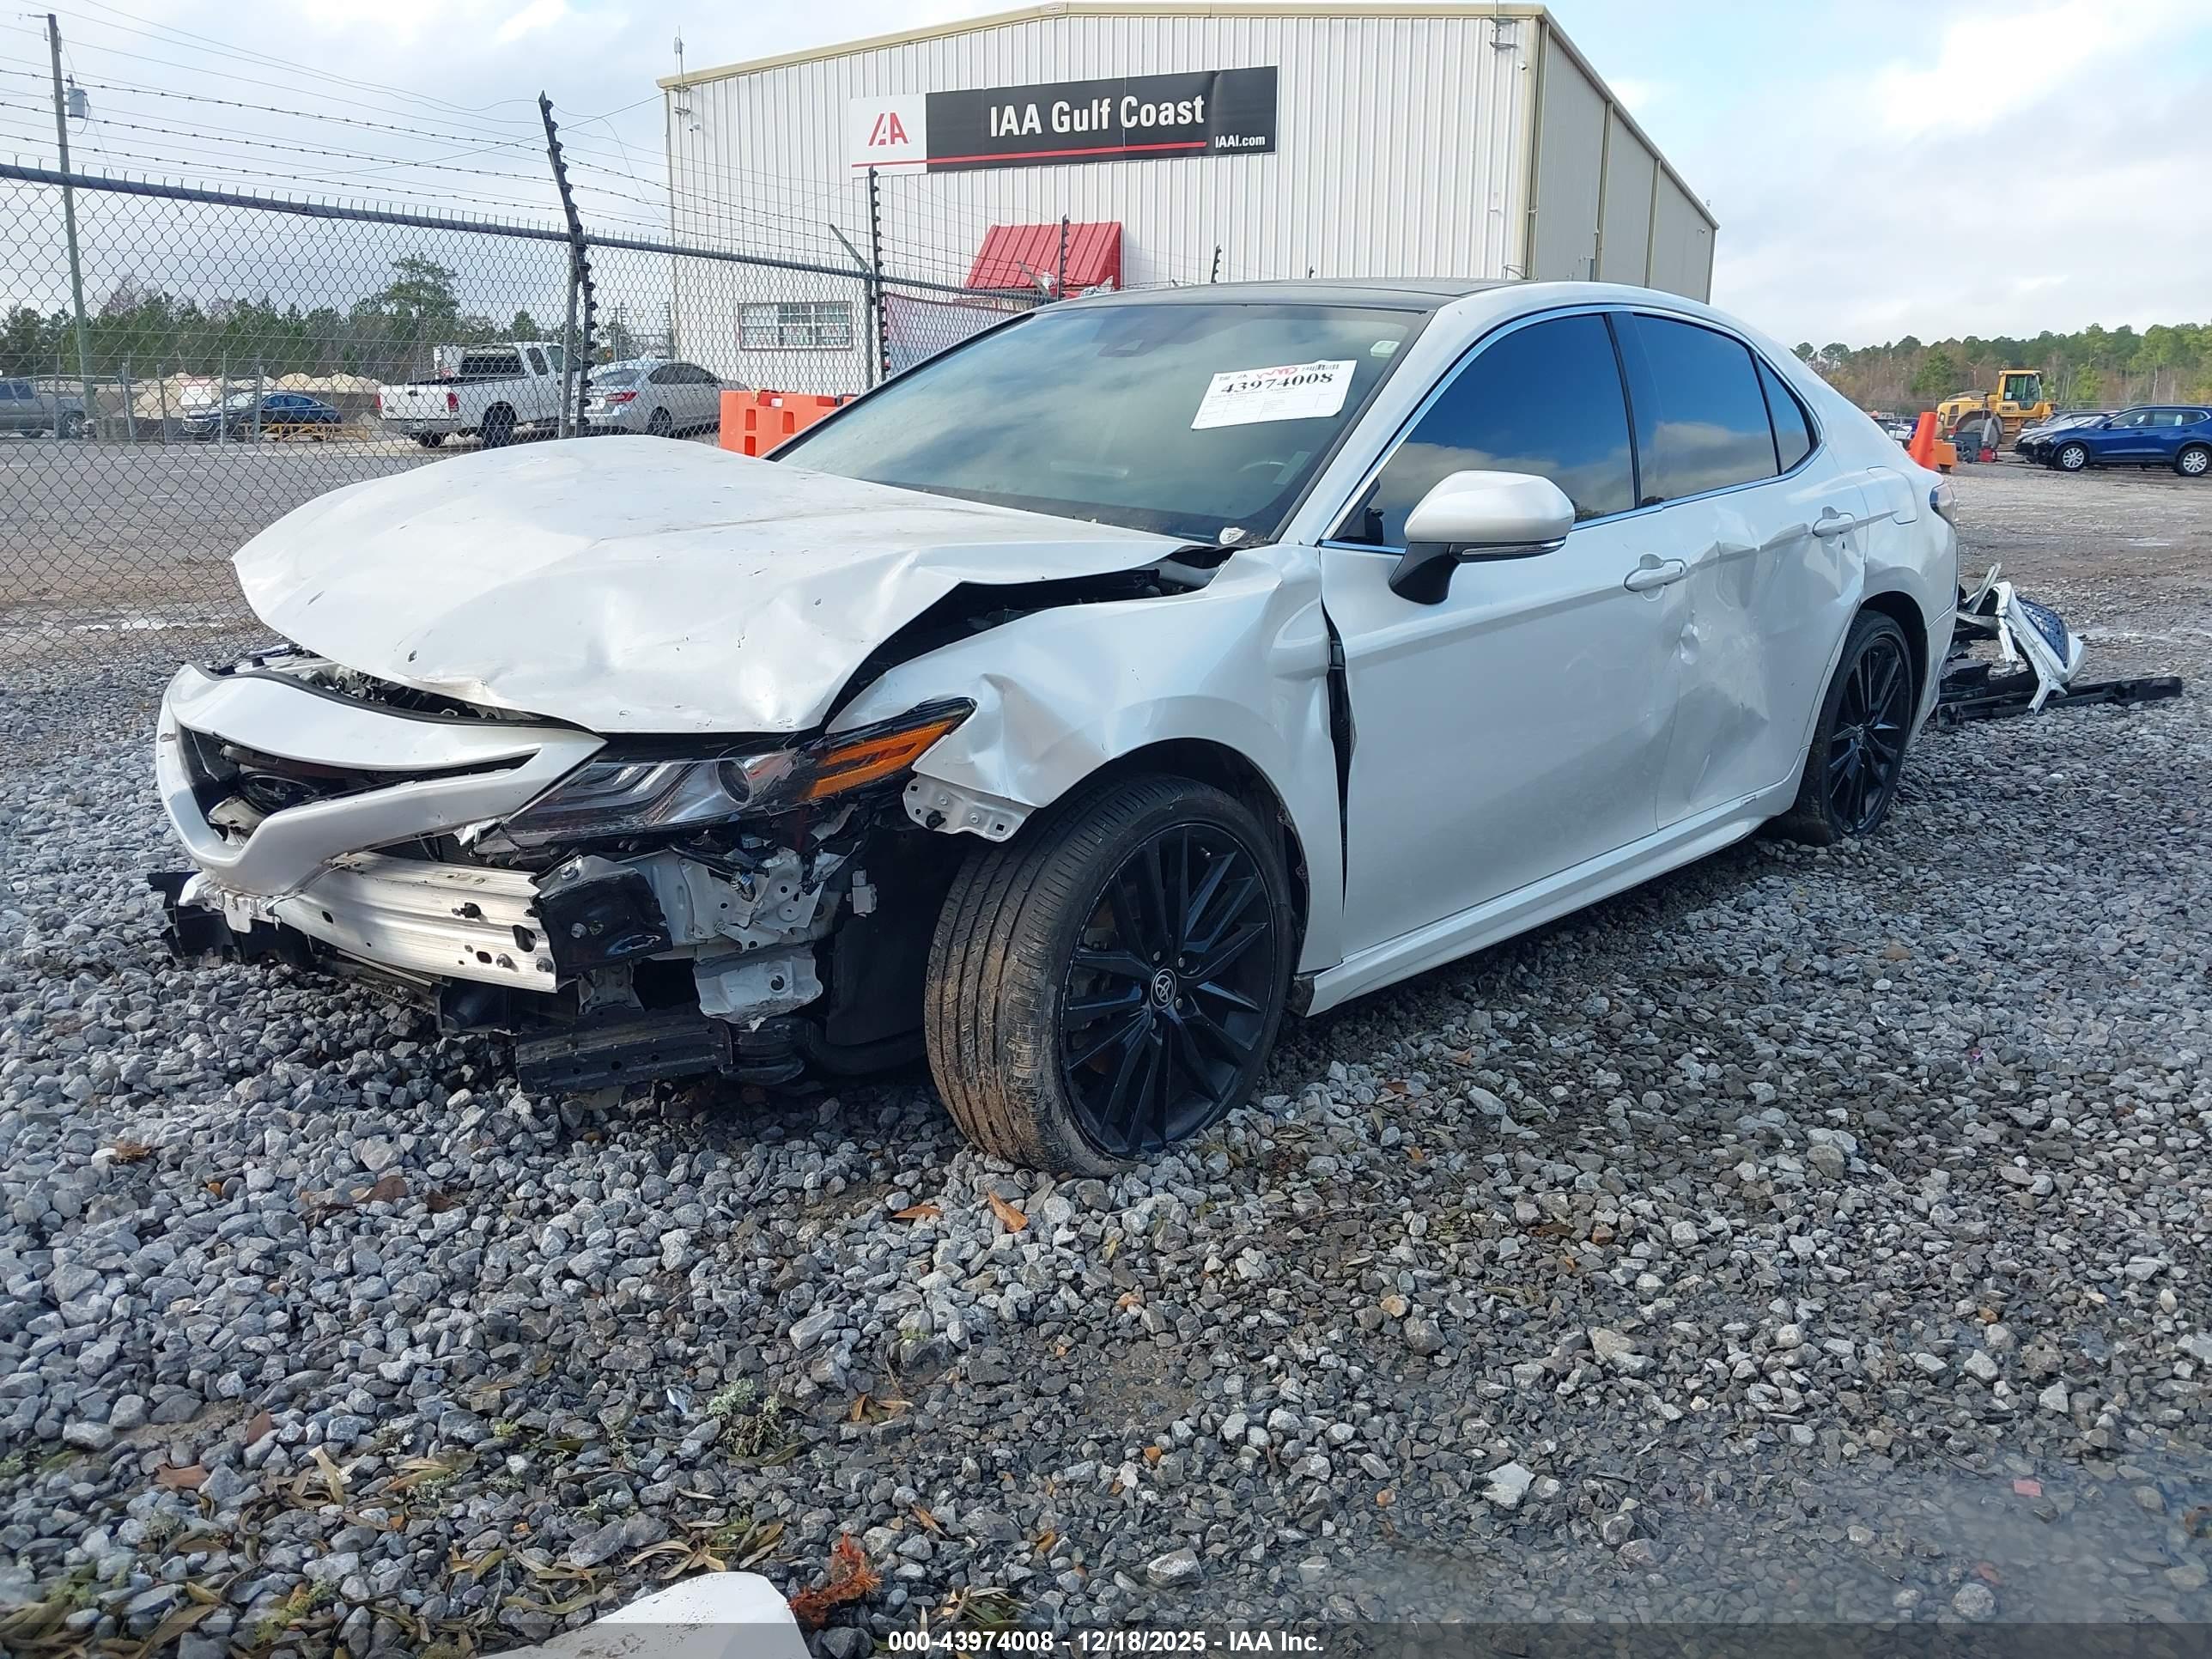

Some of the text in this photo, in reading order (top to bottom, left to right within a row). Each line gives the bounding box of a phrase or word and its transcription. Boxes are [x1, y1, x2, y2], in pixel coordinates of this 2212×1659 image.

[990, 94, 1205, 137] IAA Gulf Coast
[1215, 134, 1266, 149] IAAI.com
[1221, 372, 1334, 393] 43974008
